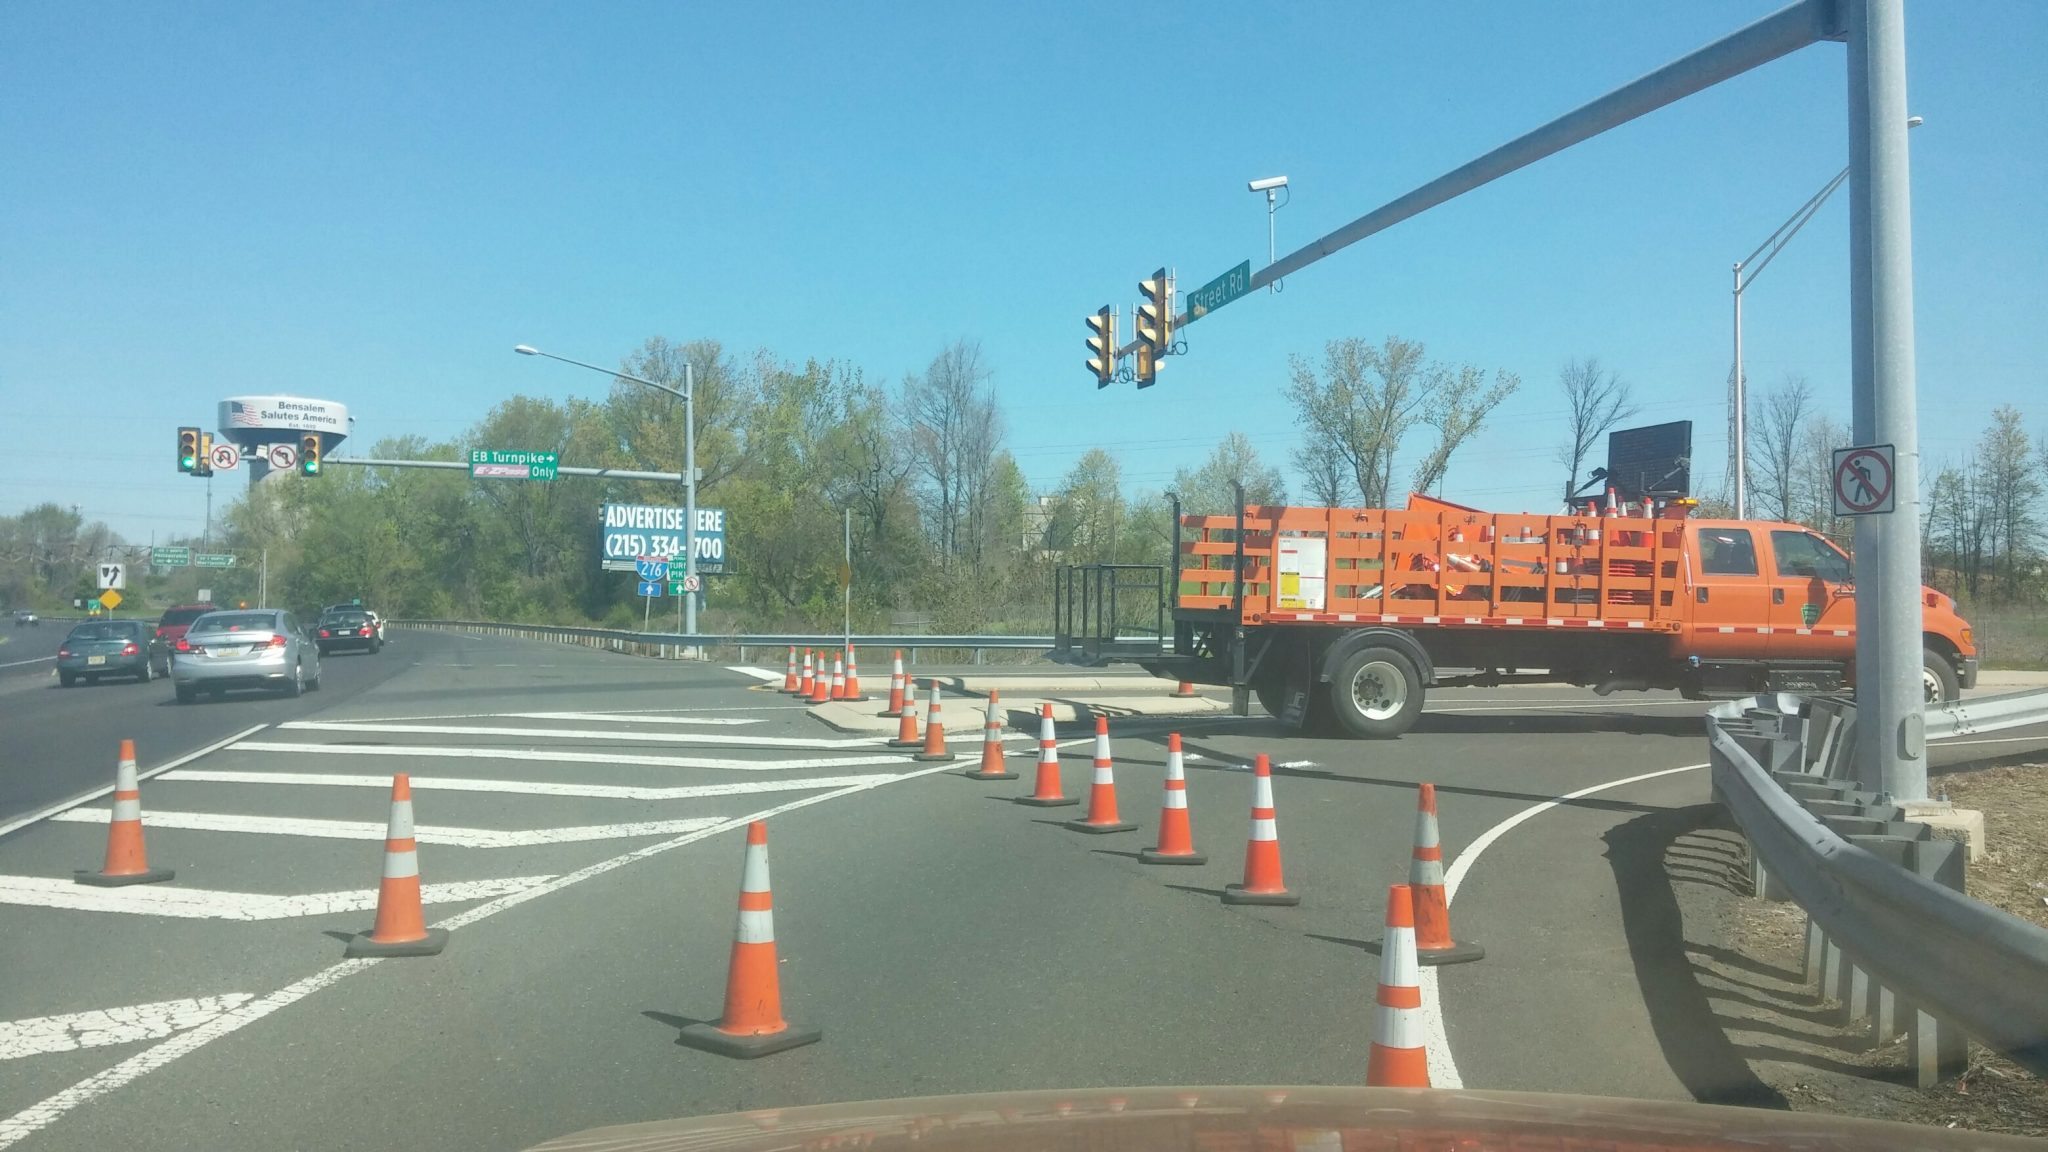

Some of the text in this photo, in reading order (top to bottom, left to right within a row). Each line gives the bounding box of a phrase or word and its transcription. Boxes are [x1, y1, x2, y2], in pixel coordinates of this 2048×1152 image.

[1194, 268, 1243, 310] Street Rd
[279, 402, 325, 413] Bensalem
[260, 410, 337, 424] Salutes America
[472, 451, 545, 465] EB Turnpike
[532, 466, 555, 479] Only
[606, 506, 683, 529] ADVERTISE
[605, 533, 721, 559] (215) 334-700
[641, 561, 662, 577] 276
